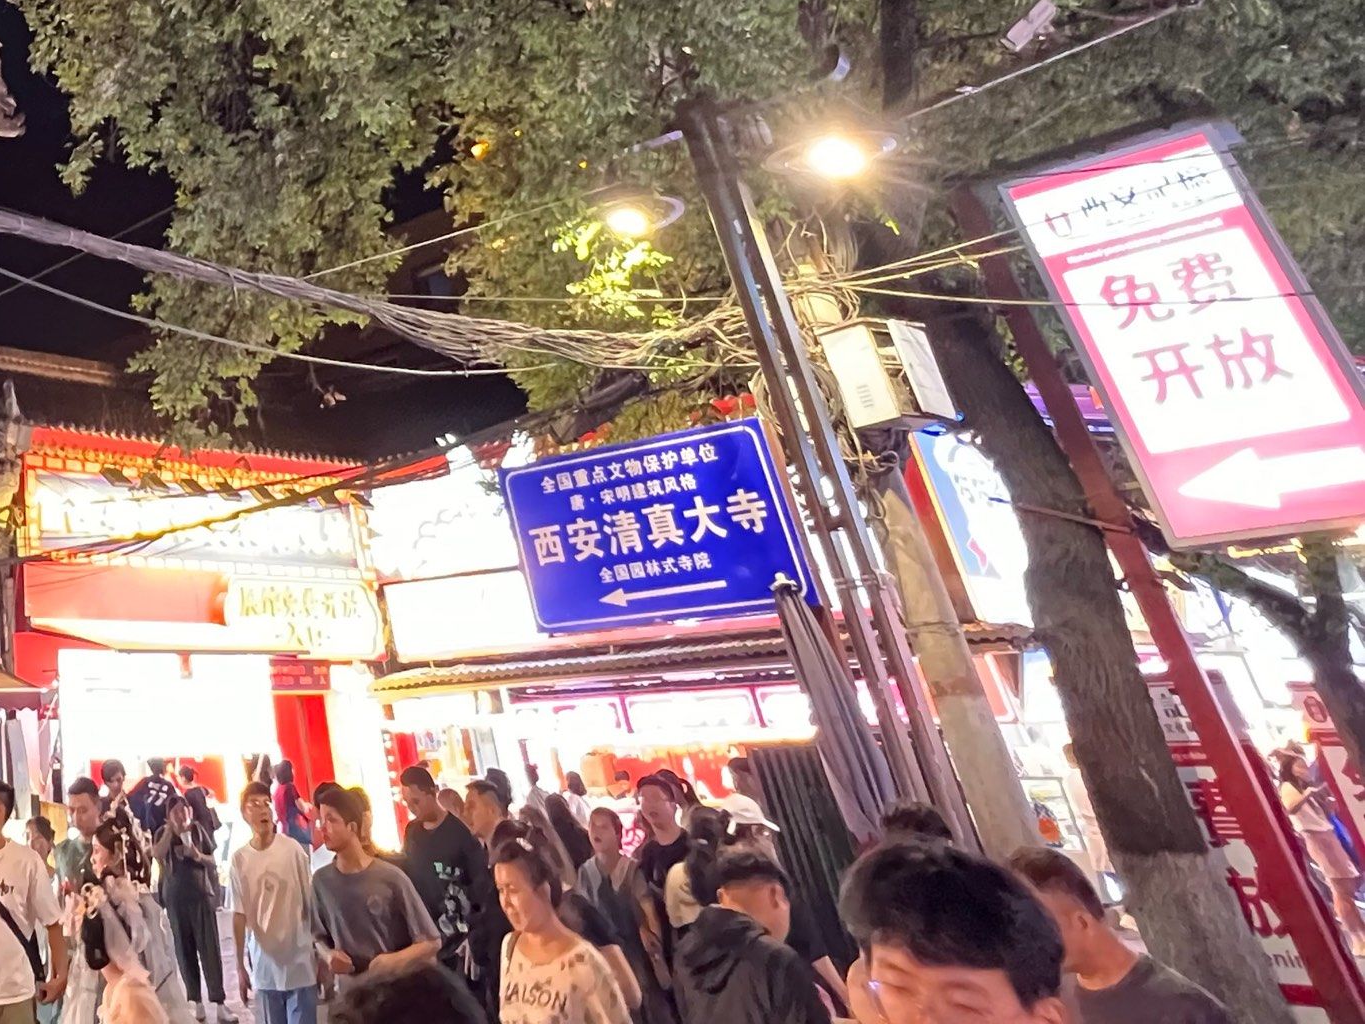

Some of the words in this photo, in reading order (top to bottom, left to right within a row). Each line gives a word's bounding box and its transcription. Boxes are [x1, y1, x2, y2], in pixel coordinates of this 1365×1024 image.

[1099, 252, 1237, 330] 免费
[1132, 326, 1294, 405] 开放
[540, 443, 718, 494] 全国重点文物保护单位
[528, 488, 767, 566] 西安清真大寺
